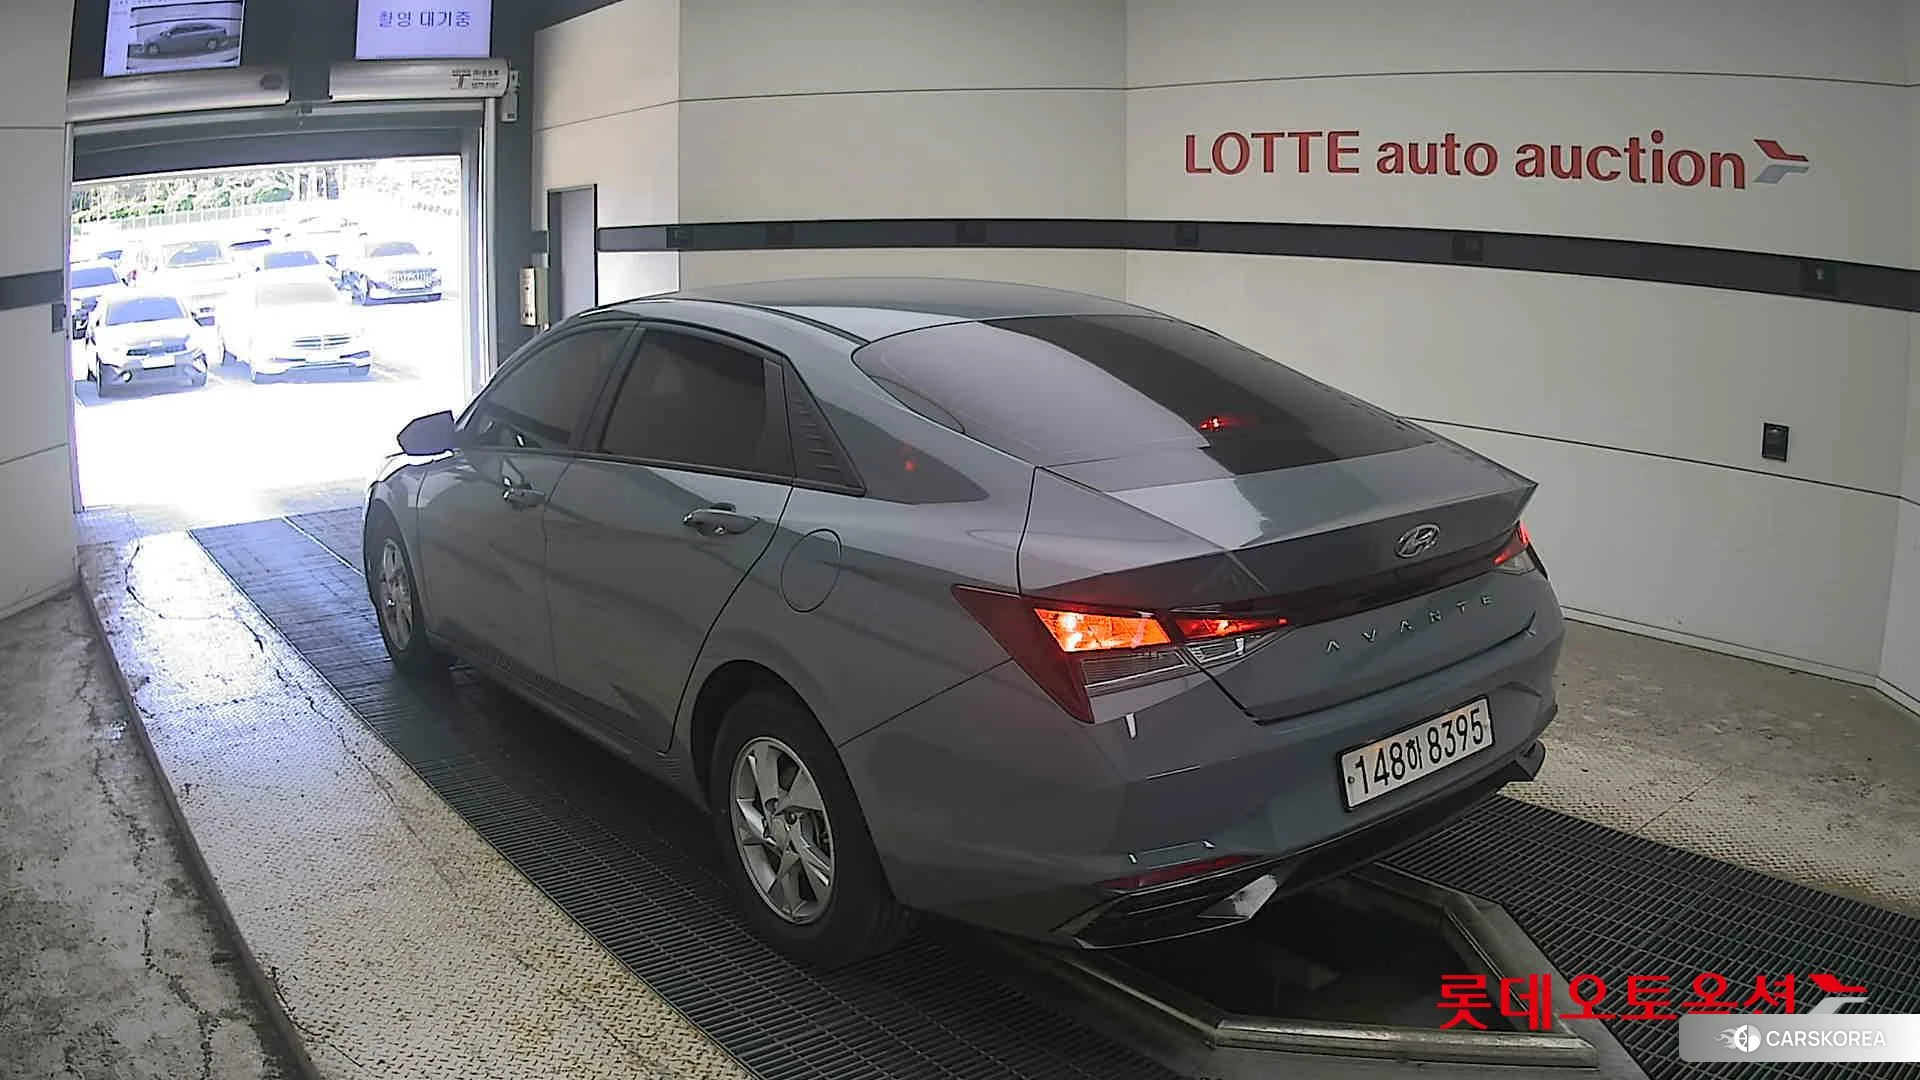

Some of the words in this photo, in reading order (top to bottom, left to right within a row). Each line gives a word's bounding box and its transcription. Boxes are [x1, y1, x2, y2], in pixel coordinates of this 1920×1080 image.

[420, 10, 472, 28] 대기중
[1185, 130, 1361, 174] LOTTE
[1376, 132, 1498, 176] auto
[1515, 129, 1746, 189] auction
[1326, 594, 1496, 654] AVANTE
